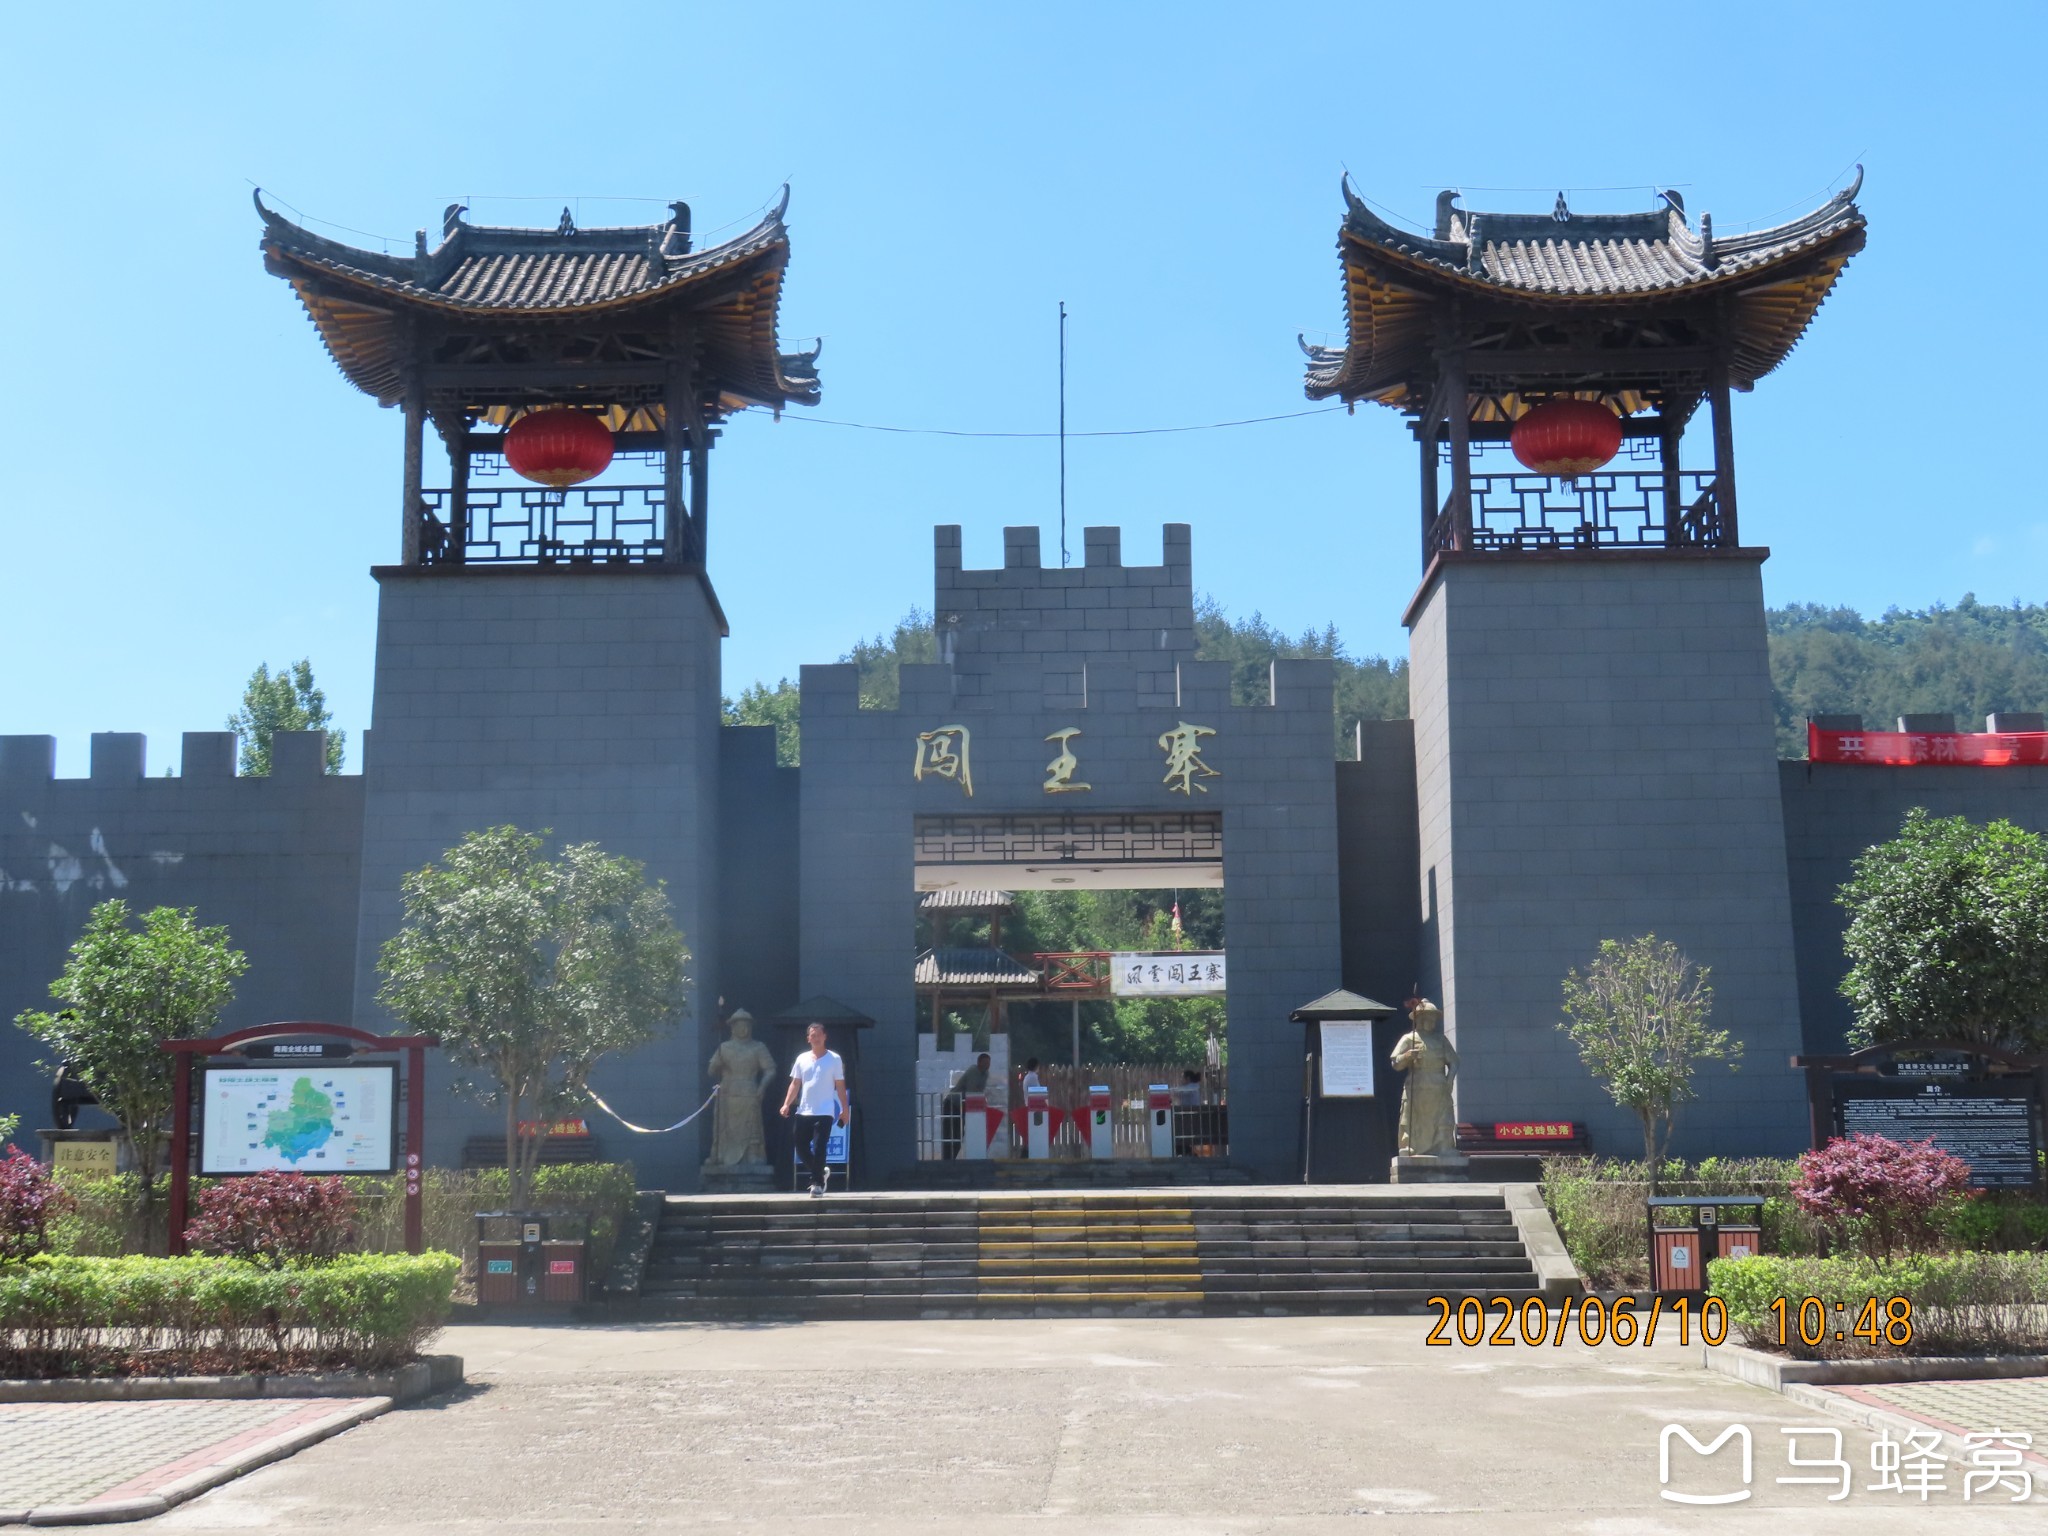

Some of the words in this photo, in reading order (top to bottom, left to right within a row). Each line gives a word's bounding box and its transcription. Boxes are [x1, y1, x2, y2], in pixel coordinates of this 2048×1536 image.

[1499, 1125, 1570, 1136] 小心瓷砖坠落
[61, 1148, 110, 1161] 注意安全
